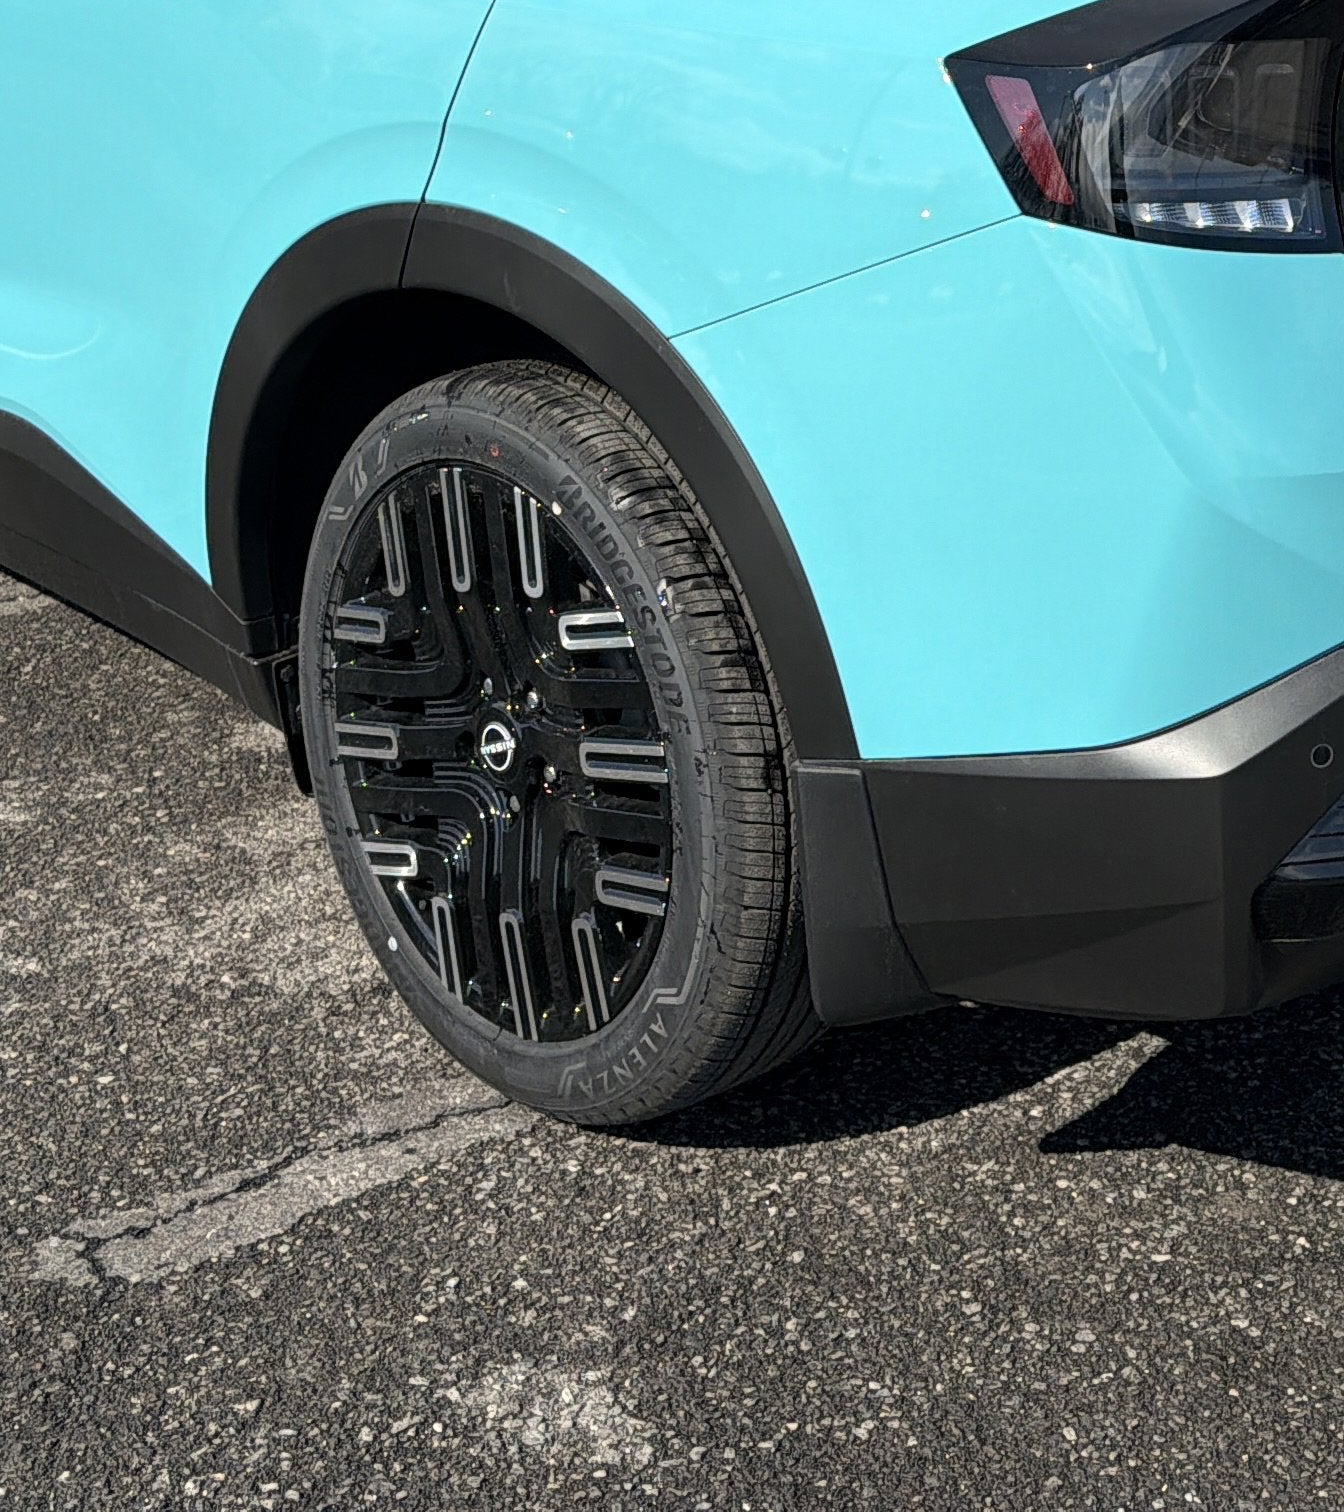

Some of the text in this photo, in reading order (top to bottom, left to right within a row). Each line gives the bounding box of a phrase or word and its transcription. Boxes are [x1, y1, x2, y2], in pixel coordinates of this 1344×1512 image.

[554, 473, 692, 736] BRIDGESTONE
[480, 738, 517, 755] NISSAN
[577, 1012, 670, 1099] ALENZA
